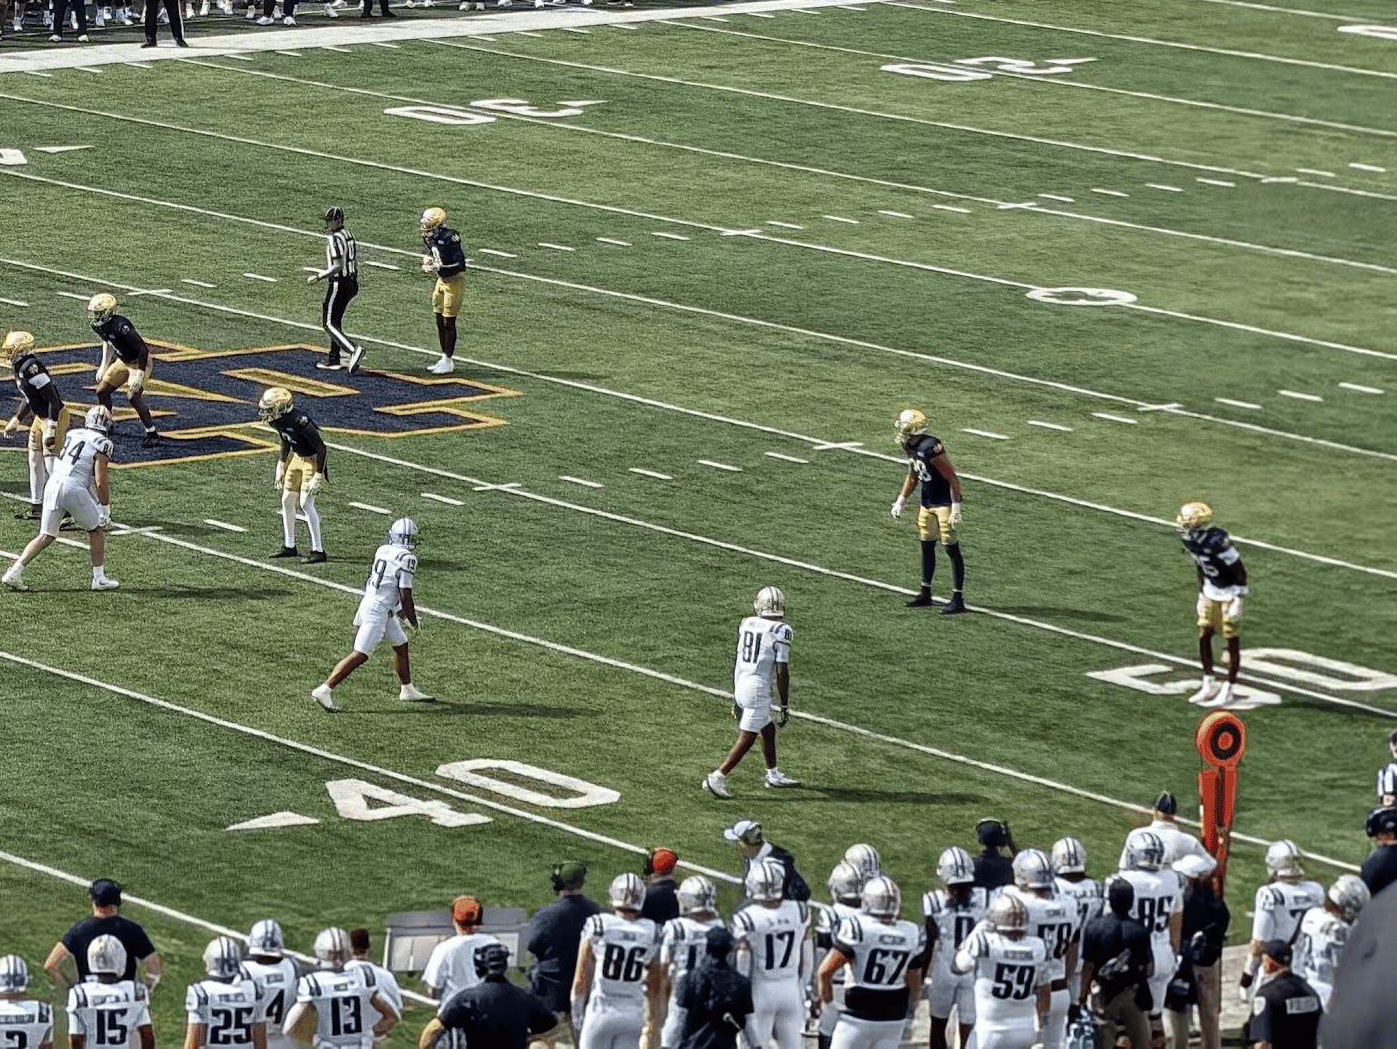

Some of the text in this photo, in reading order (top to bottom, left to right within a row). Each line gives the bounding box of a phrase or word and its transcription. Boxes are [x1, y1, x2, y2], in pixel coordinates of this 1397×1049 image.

[384, 99, 583, 125] 30
[742, 630, 763, 664] 81
[324, 758, 621, 828] 40
[602, 942, 648, 983] 86
[764, 929, 796, 970] 17
[862, 947, 910, 985] 67
[991, 962, 1036, 1000] 59
[95, 1008, 128, 1045] 15
[209, 1006, 254, 1045] 25
[330, 995, 363, 1036] 13
